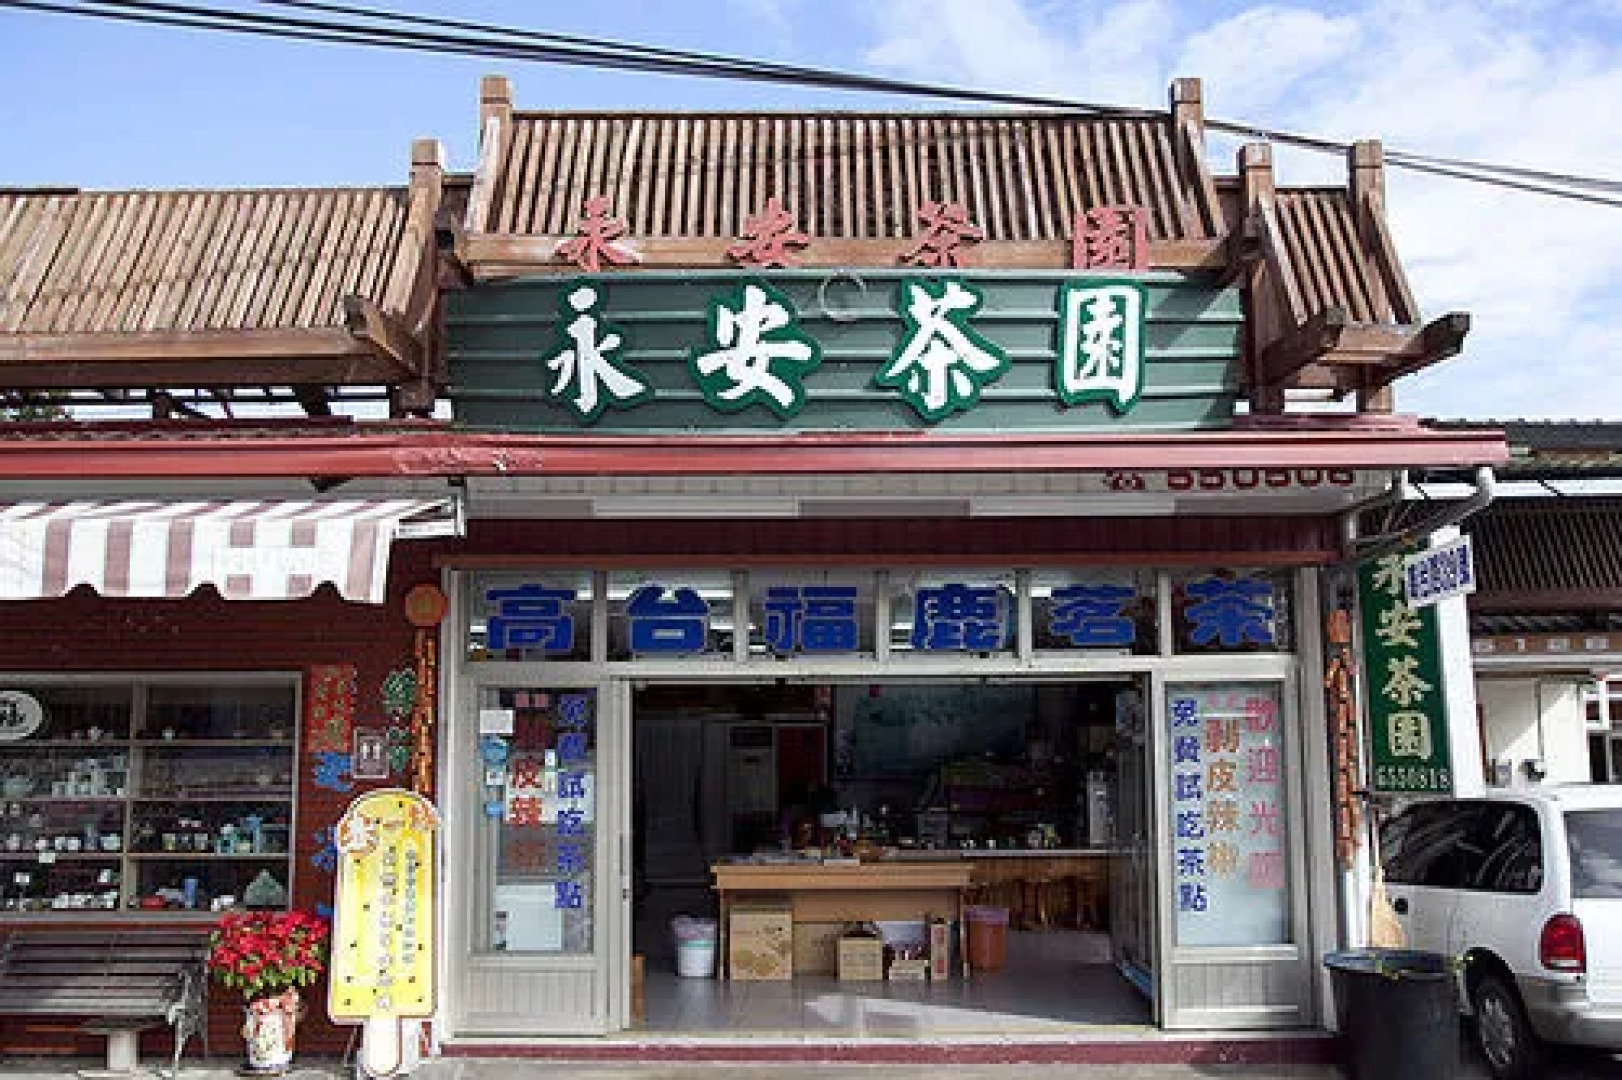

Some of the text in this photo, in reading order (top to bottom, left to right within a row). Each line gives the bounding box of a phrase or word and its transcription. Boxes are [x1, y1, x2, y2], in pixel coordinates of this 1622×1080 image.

[549, 282, 1141, 413] 永安茶園
[486, 579, 1273, 653] 高台福鹿茗茶
[506, 713, 548, 870] 皮辣
[1172, 698, 1208, 912] 免費試吃茶點
